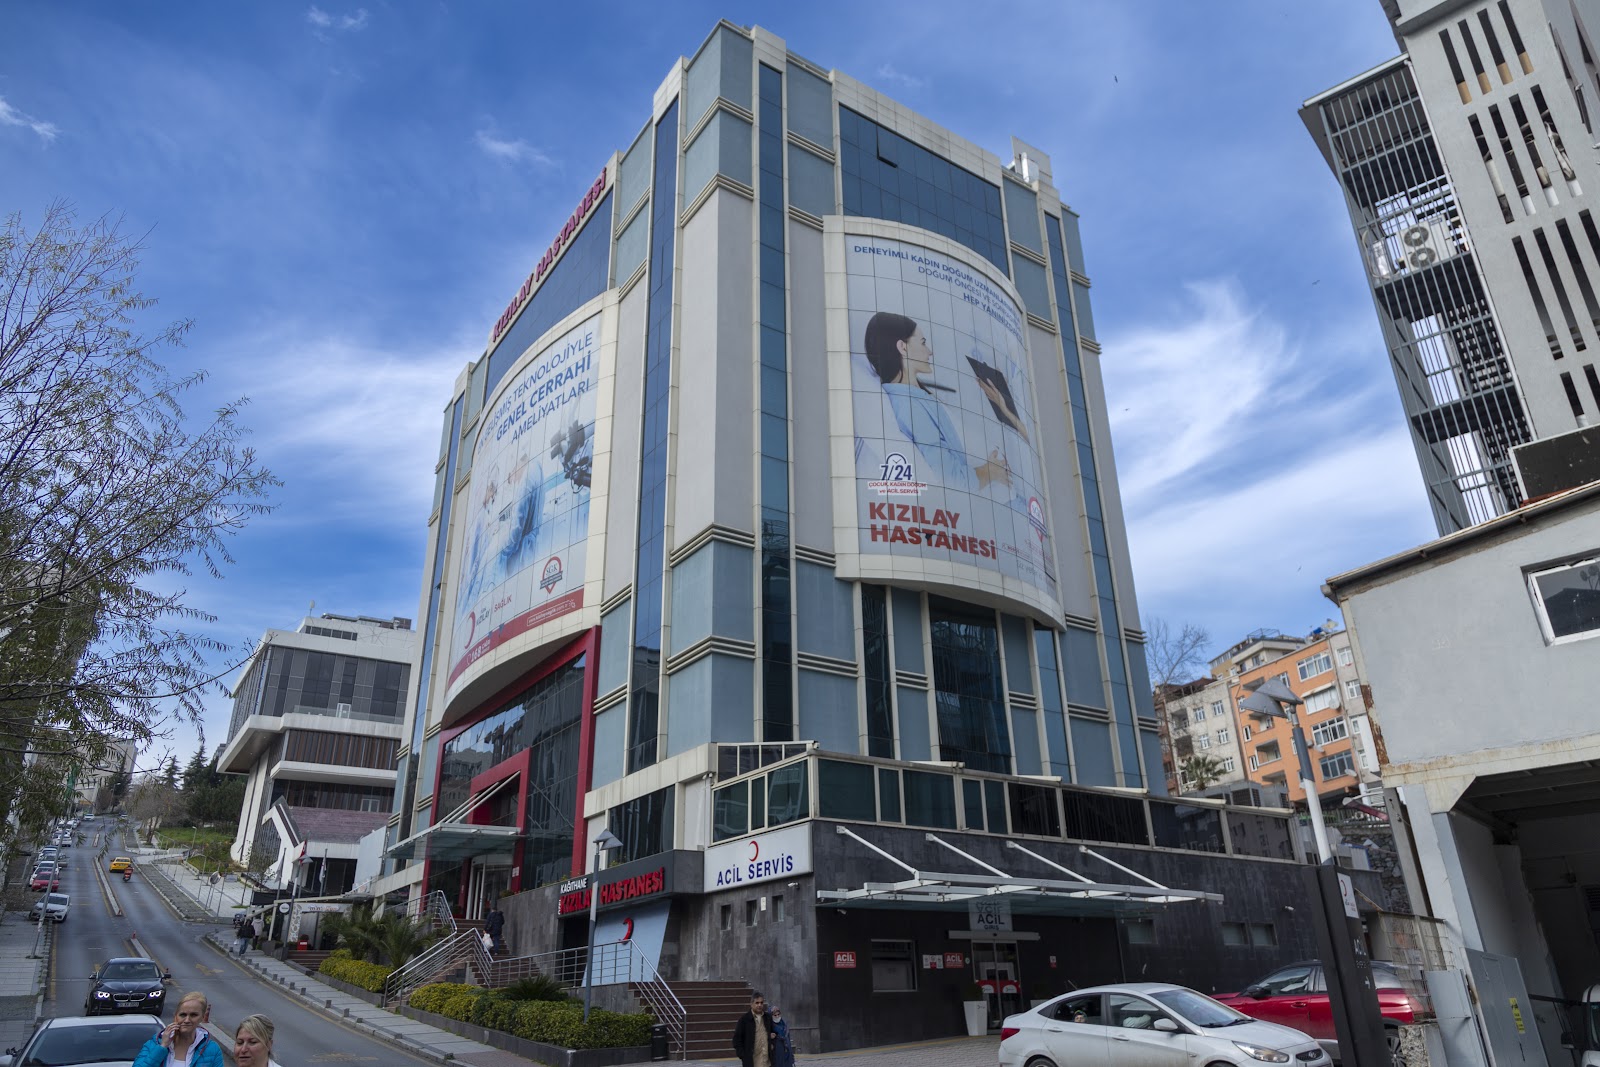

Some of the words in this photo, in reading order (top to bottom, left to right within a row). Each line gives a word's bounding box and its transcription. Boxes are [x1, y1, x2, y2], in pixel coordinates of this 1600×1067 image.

[493, 273, 534, 342] KIZILAY
[535, 166, 607, 282] HASTANESİ
[854, 245, 909, 260] DENEYİMLİ
[911, 254, 940, 269] KADIN
[942, 264, 973, 283] DOĞUM
[918, 266, 953, 283] DOĞUM
[963, 292, 980, 306] HEP
[513, 331, 593, 402] TEKNOLOJİYLE
[496, 401, 527, 441] GENEL
[529, 350, 592, 408] CERRAHİ
[511, 378, 590, 445] AMELİYATLARI
[880, 464, 913, 481] 7/24
[869, 502, 960, 529] KIZILAY
[716, 864, 743, 887] ACİL
[748, 853, 794, 880] SERVİS
[560, 877, 588, 894] KAĞITHANE
[600, 868, 665, 905] HASTANESİ
[836, 952, 855, 962] ACİL
[946, 953, 962, 963] ACİL
